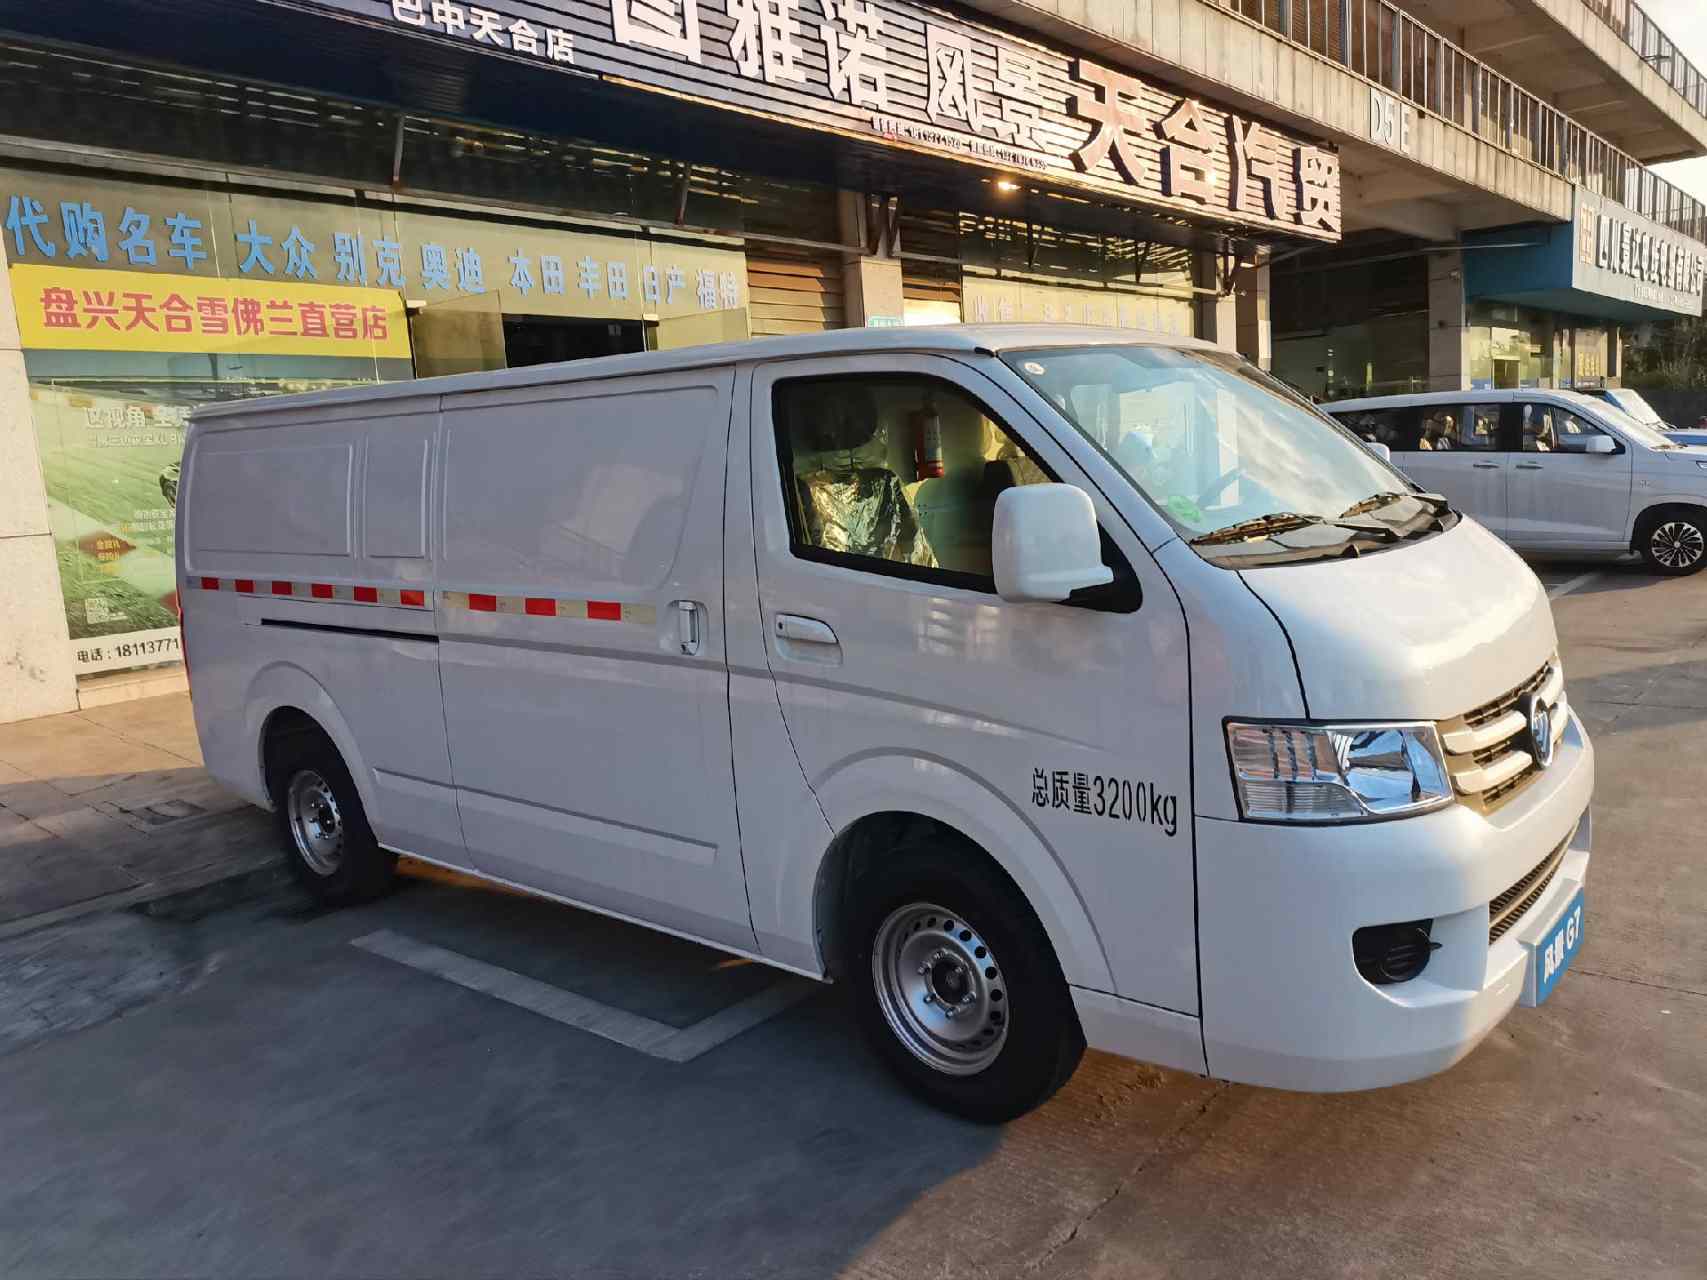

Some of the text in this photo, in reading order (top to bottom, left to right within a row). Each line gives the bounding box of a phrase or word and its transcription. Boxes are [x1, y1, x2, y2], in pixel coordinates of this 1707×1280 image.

[392, 0, 576, 64] 巴中天合店
[925, 23, 1048, 152] 风景
[1068, 58, 1341, 234] 天合汽贸
[7, 195, 208, 269] 代购名车
[236, 219, 317, 279] 大众
[332, 231, 406, 287] 别克
[420, 243, 486, 294] 奥迪
[508, 247, 564, 296] 本田
[577, 255, 629, 300] 丰田
[642, 262, 686, 304] 日产
[40, 286, 389, 341] 盘兴天合雪佛兰直营店
[1032, 767, 1177, 837] 总质量3200kg
